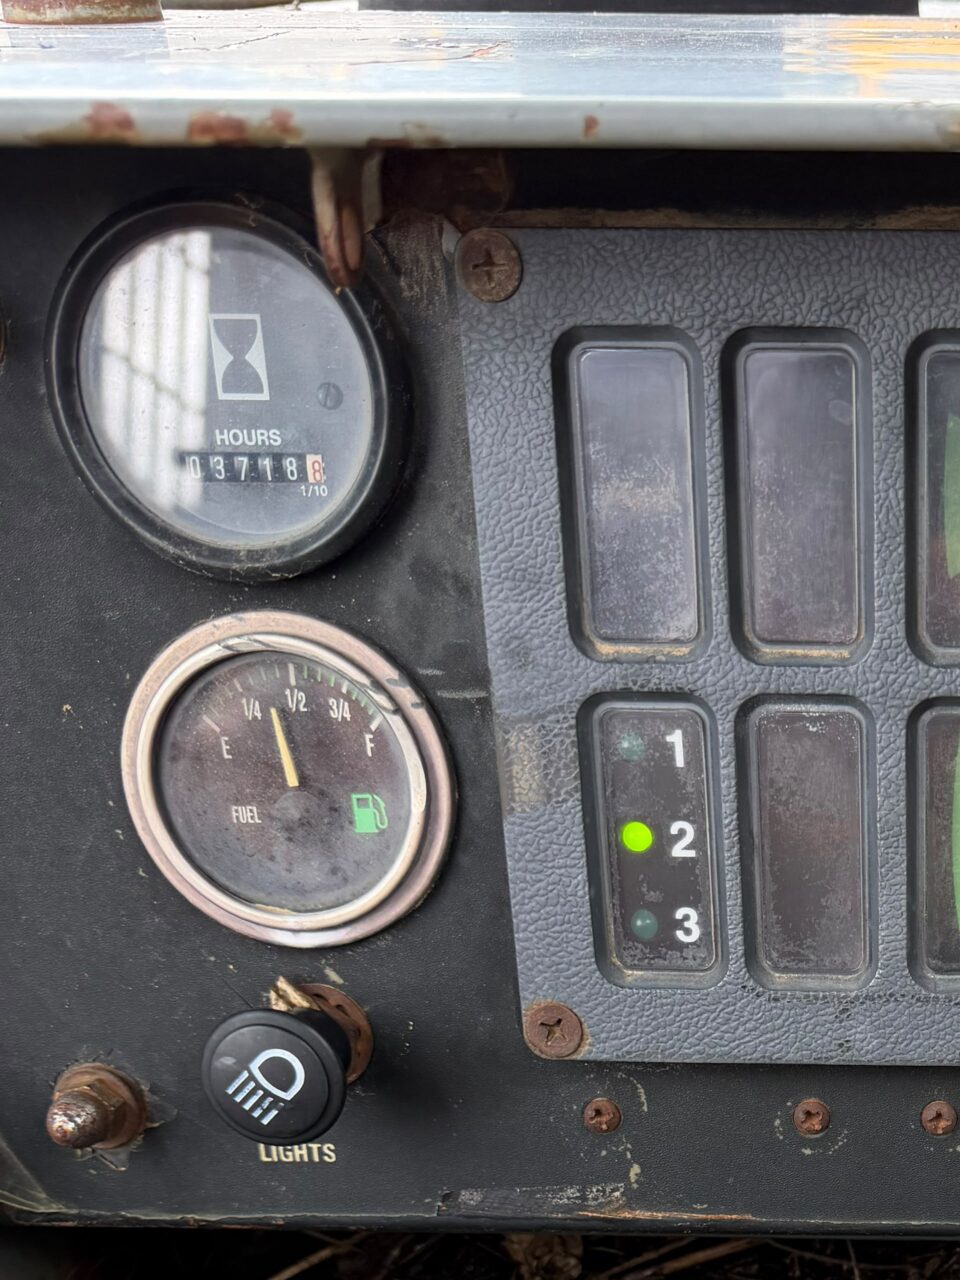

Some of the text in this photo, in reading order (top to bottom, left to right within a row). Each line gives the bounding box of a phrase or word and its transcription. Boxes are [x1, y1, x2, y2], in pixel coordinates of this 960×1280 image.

[215, 429, 282, 446] HOURS
[300, 485, 328, 497] 1/10
[242, 697, 262, 720] 1/4
[285, 688, 308, 713] 1/2
[329, 698, 351, 722] 3/4
[221, 736, 232, 760] E
[364, 734, 375, 757] F
[665, 729, 685, 768] 1
[231, 806, 262, 824] FUEL
[670, 821, 696, 858] 2
[675, 907, 701, 943] 3
[258, 1143, 337, 1163] LIGHTS
